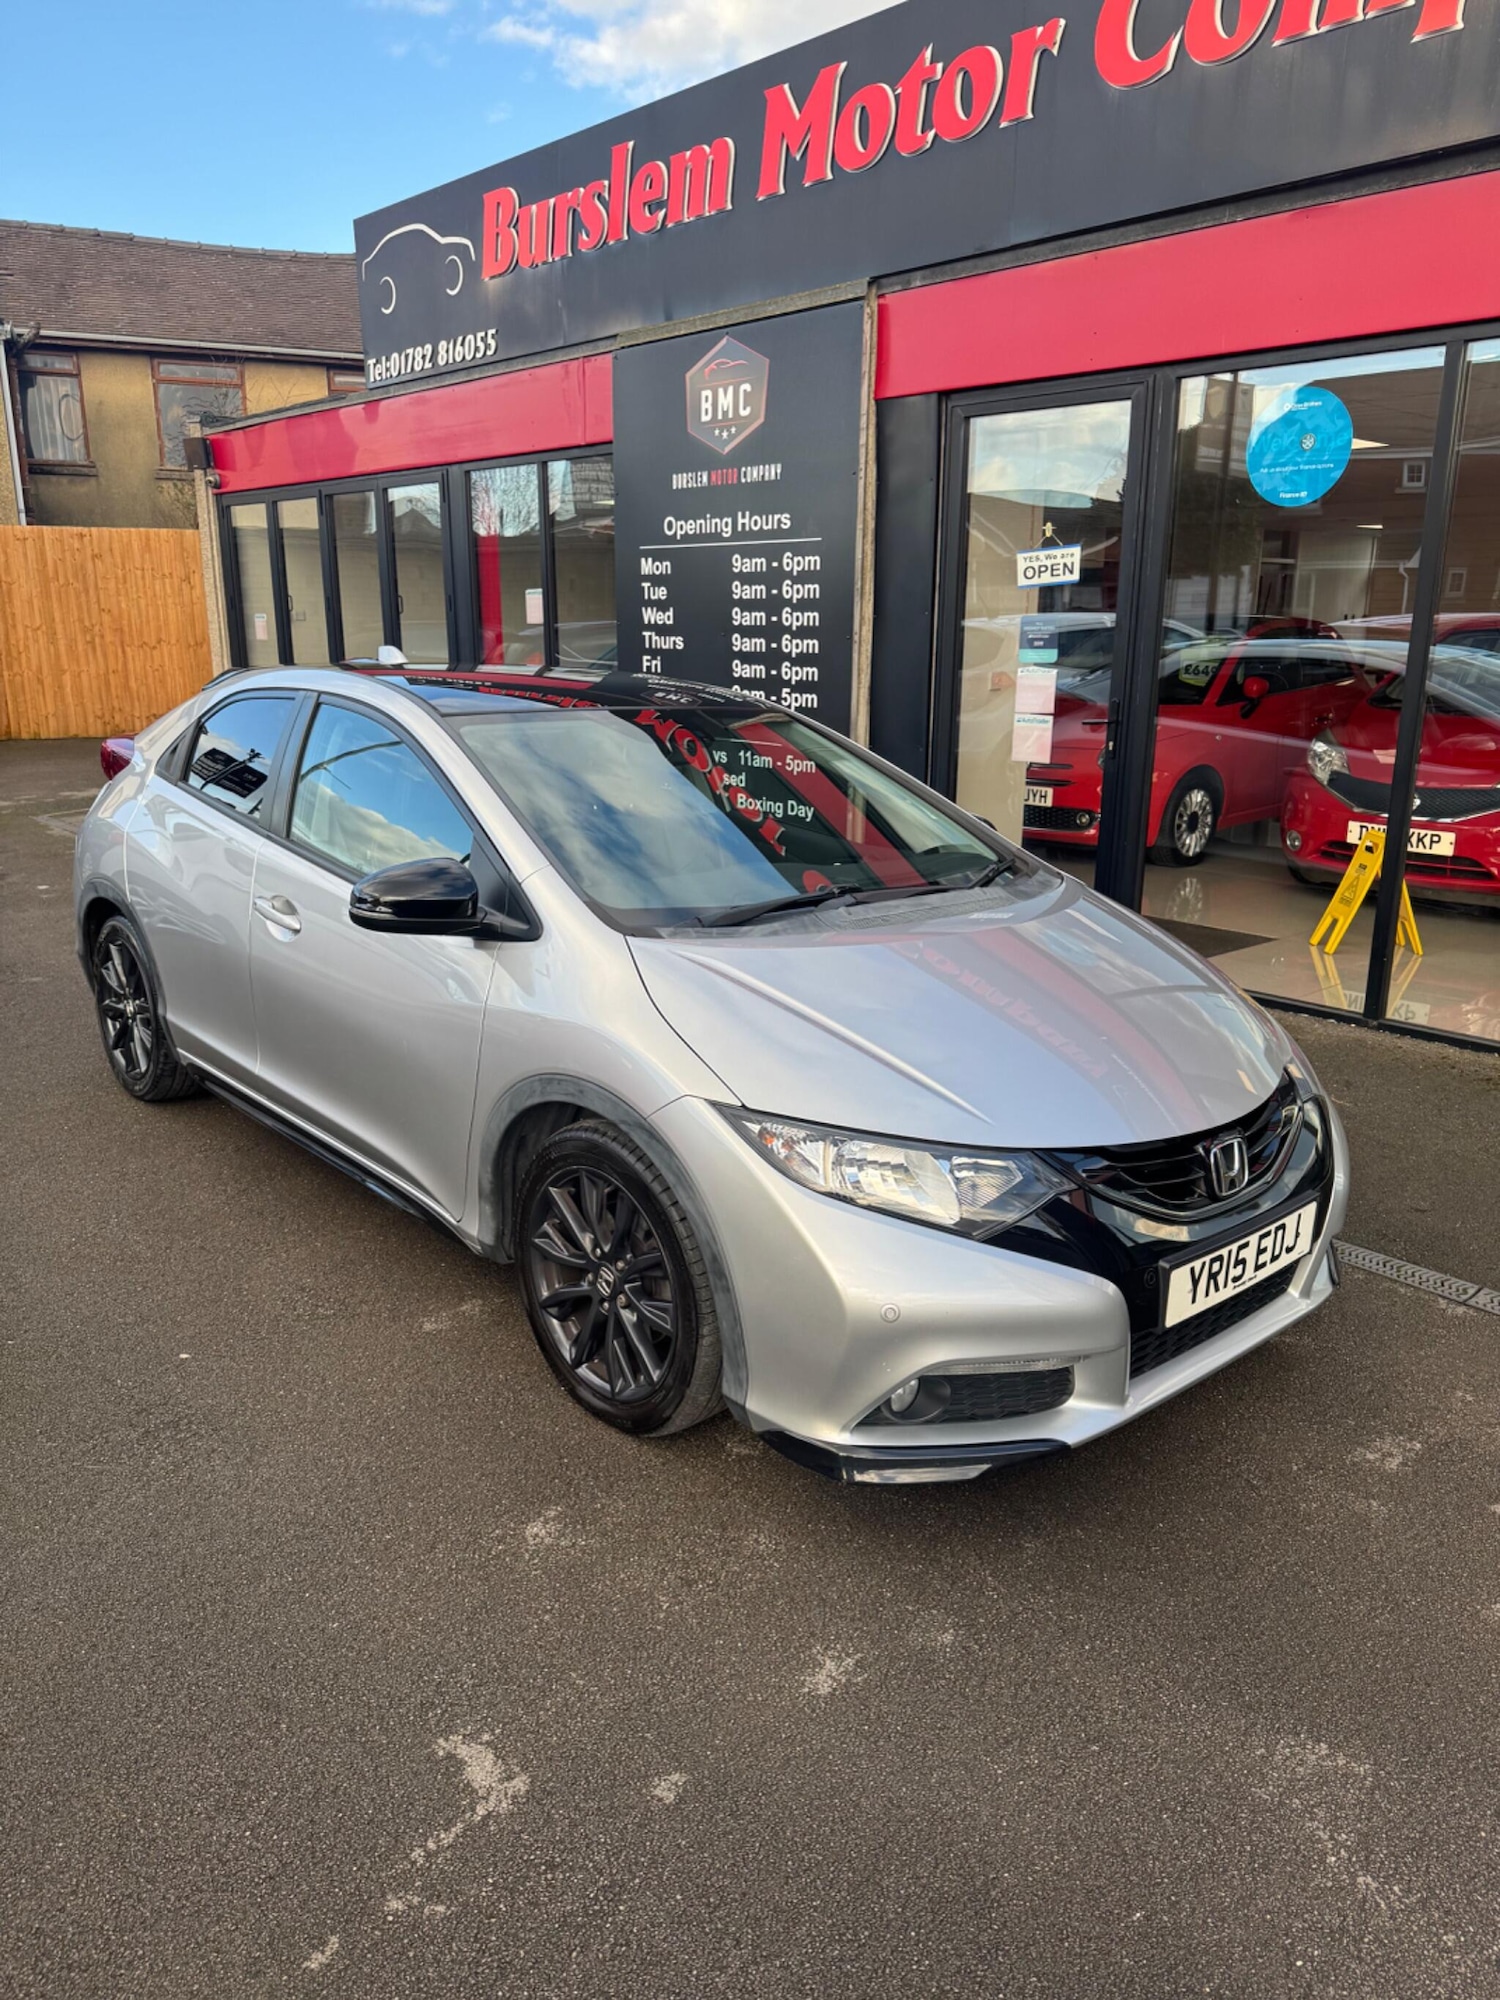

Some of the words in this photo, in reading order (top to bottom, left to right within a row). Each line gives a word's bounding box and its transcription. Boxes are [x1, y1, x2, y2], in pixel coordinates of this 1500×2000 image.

[480, 137, 735, 281] Burslem
[755, 18, 1067, 202] Motor
[367, 343, 433, 383] Tel:01782
[437, 328, 498, 366] 816055
[700, 383, 752, 423] BMC
[710, 468, 738, 486] MOTOR
[740, 463, 782, 483] COMPANY
[663, 513, 732, 540] Opening
[737, 511, 791, 532] Hours
[640, 557, 671, 575] Mon
[731, 554, 766, 572] 9am
[782, 552, 821, 576] 6pm
[1023, 561, 1075, 580] OPEN
[641, 582, 668, 600] Tue
[731, 581, 766, 599] 9am
[782, 579, 820, 603] 6pm
[641, 607, 674, 625] Wed
[731, 607, 766, 626] 9am
[781, 607, 820, 630] 6pm
[642, 631, 684, 650] Thurs
[731, 633, 766, 653] 9am
[781, 634, 819, 658] 6pm
[642, 656, 661, 673] Fri
[732, 660, 766, 679] 9am
[781, 662, 819, 685] 6pm
[781, 688, 818, 712] 5pm
[738, 750, 773, 769] 11am
[785, 755, 816, 775] 5pm
[722, 772, 746, 787] sed
[736, 793, 783, 818] Boxing
[787, 800, 814, 822] Day
[1188, 1241, 1250, 1304] YR15
[1253, 1213, 1303, 1272] EDJ
